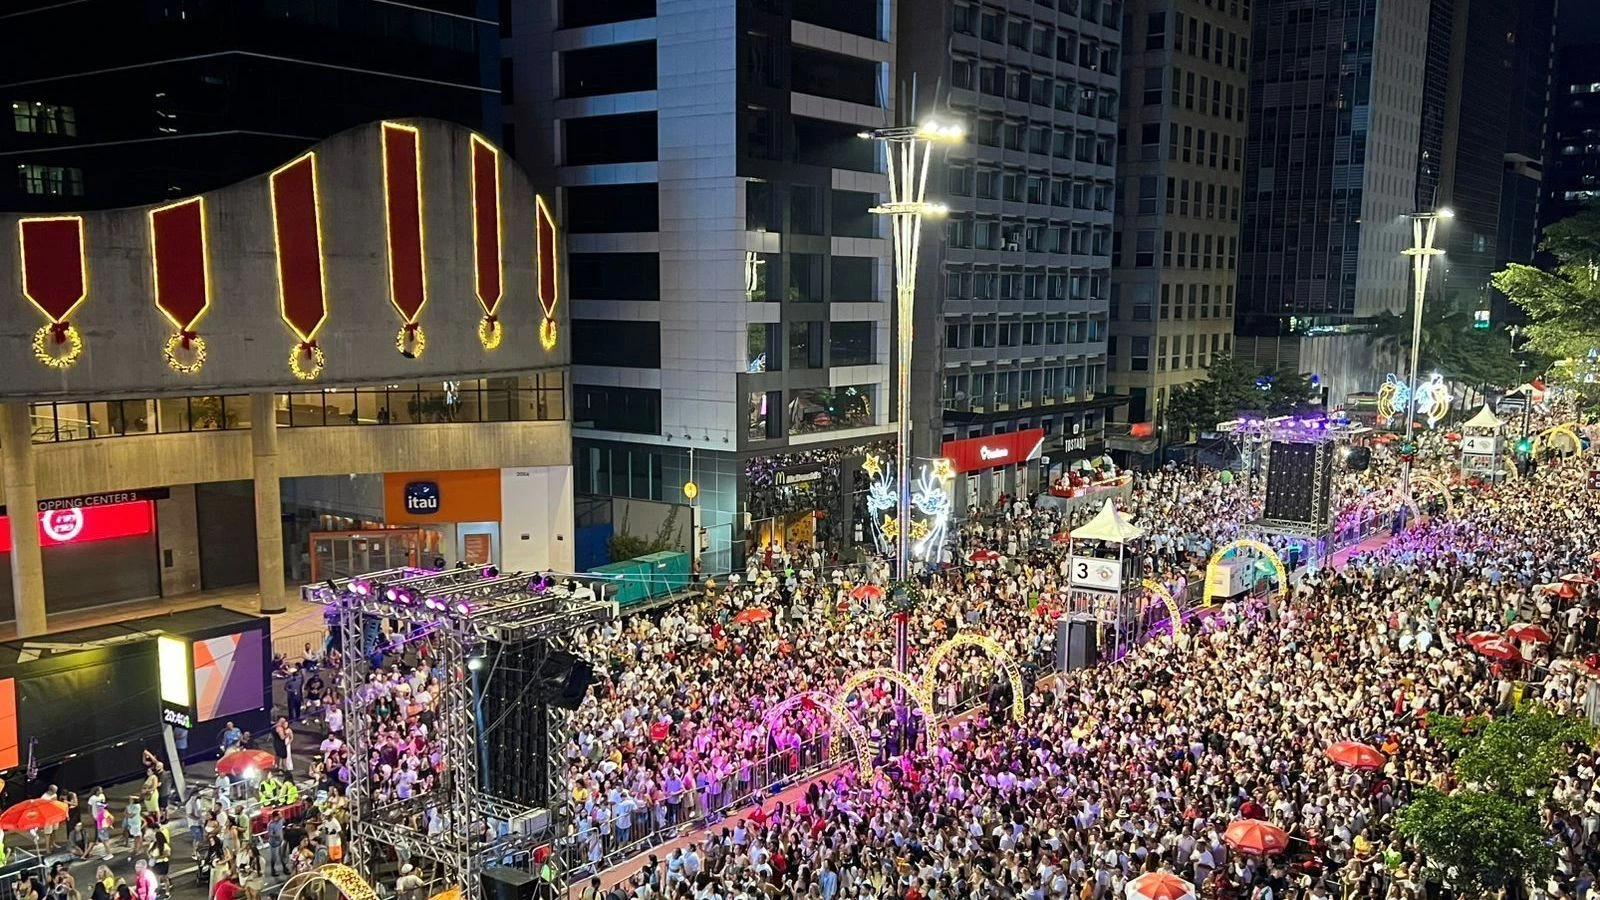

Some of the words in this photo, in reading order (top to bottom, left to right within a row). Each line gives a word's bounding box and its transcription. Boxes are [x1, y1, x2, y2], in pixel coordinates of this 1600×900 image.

[1467, 440, 1475, 448] 4
[38, 498, 83, 511] OPPING
[84, 493, 128, 506] CENTER
[128, 492, 137, 501] 3
[408, 495, 437, 509] itaú
[1077, 562, 1089, 579] 3
